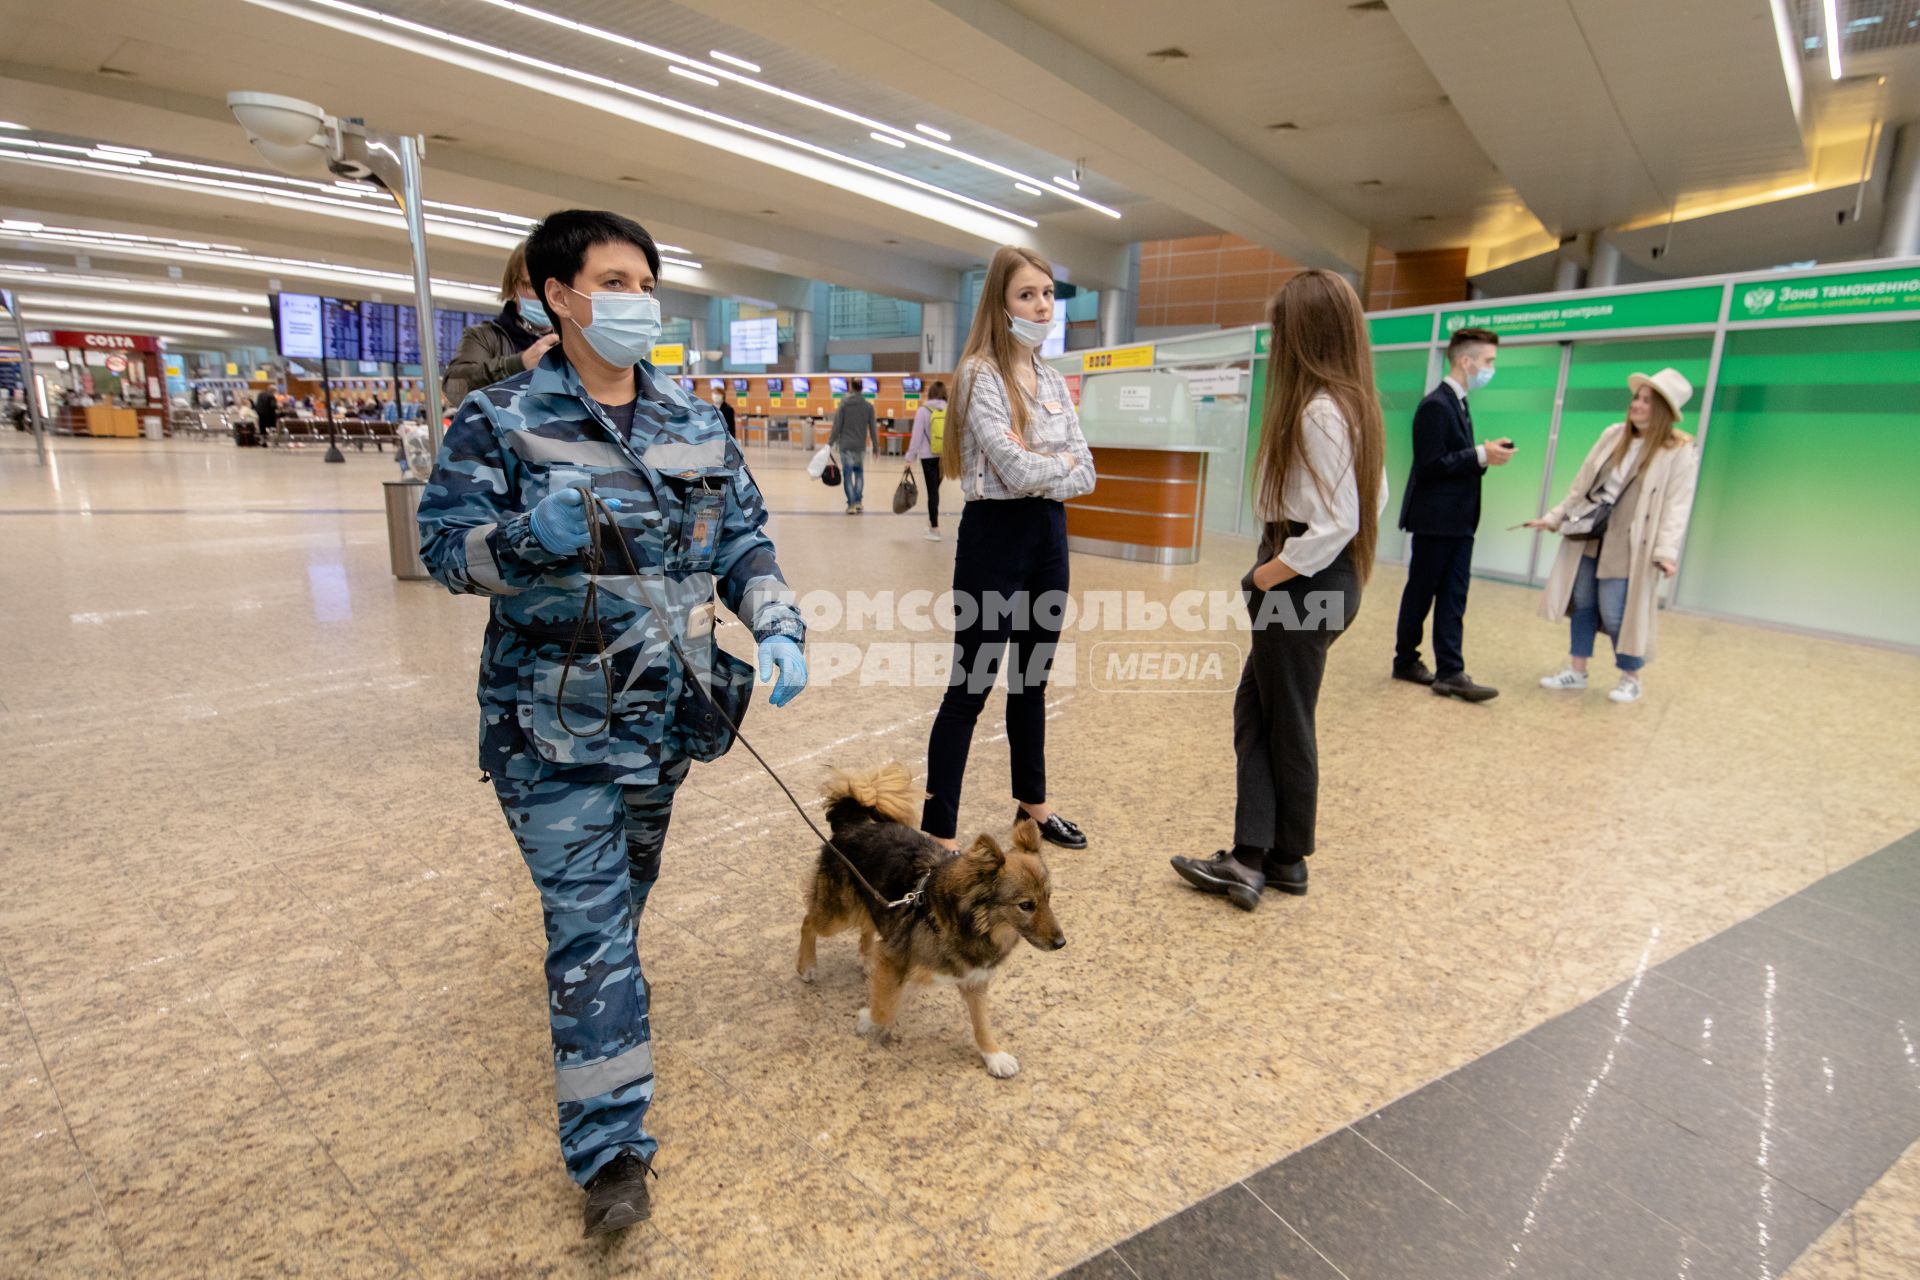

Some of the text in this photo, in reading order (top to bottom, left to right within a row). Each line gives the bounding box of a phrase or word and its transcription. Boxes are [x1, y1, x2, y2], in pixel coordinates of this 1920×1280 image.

[1779, 286, 1818, 301] Зона
[1468, 314, 1491, 327] Зона
[84, 334, 135, 348] COSTA
